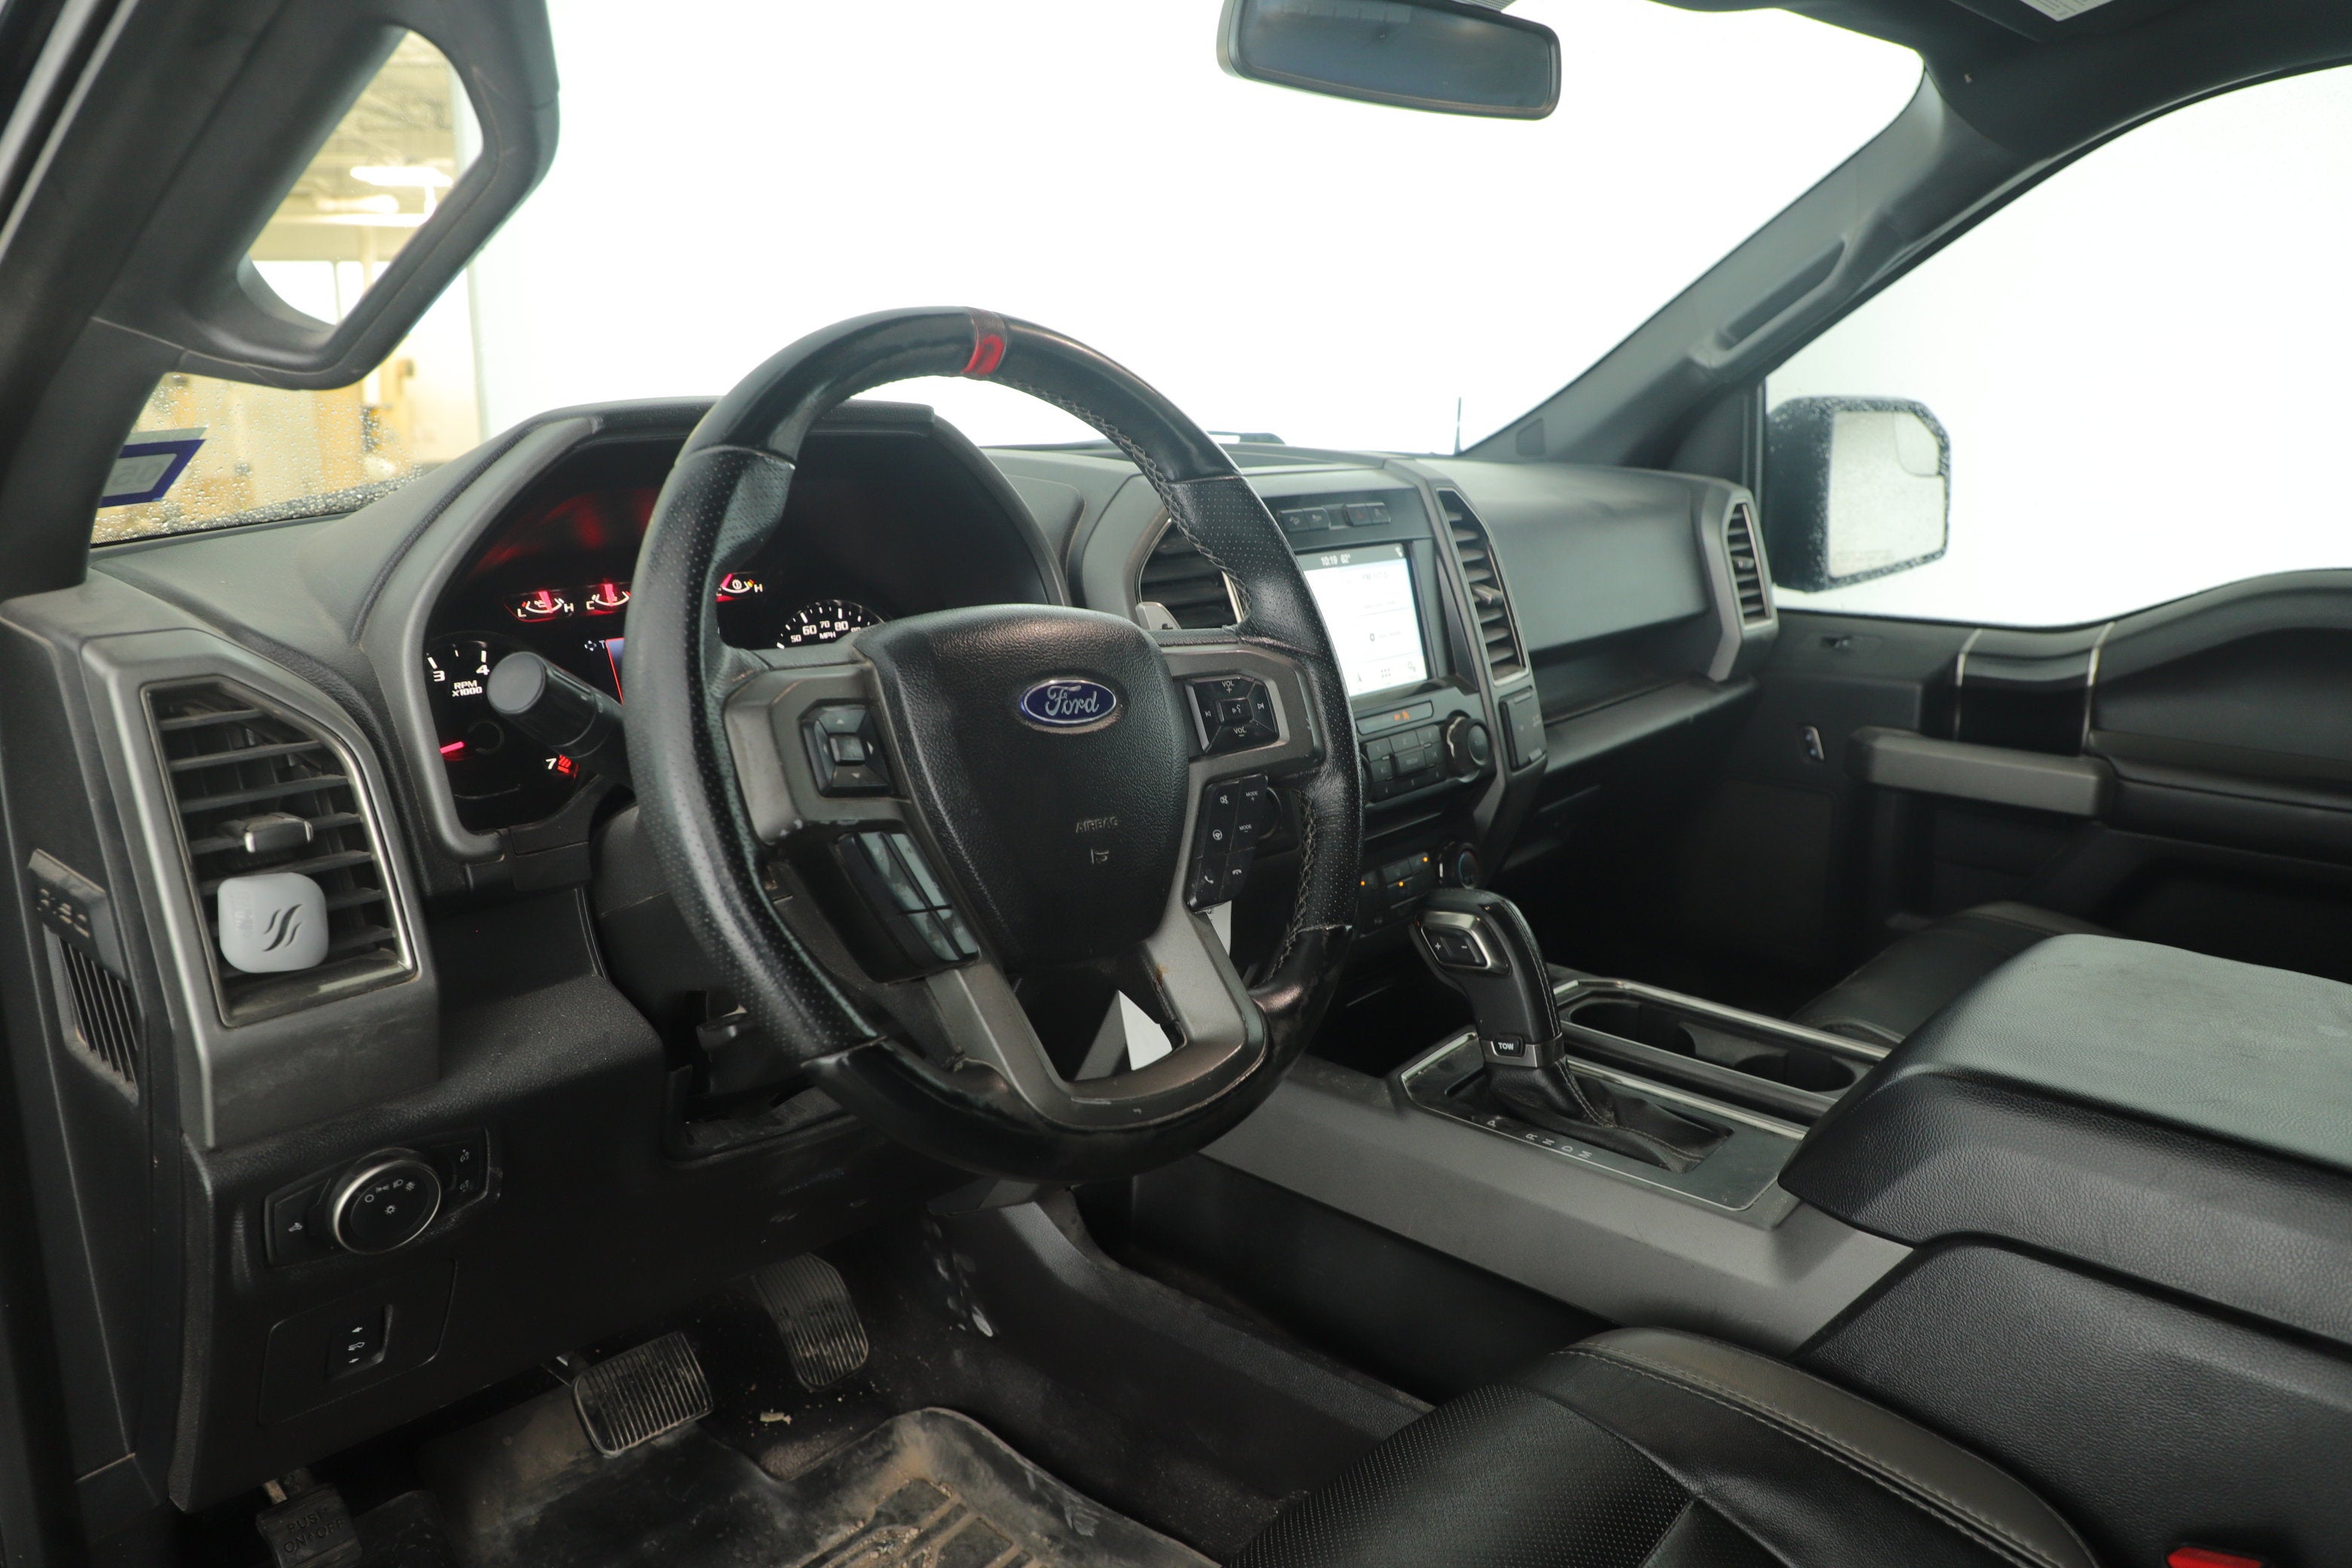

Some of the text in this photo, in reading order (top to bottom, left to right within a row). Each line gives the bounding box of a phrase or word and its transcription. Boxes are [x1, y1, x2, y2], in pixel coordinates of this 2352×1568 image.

[754, 583, 763, 593] H
[517, 608, 526, 617] L
[564, 603, 574, 613] H
[802, 624, 817, 635] 60
[819, 620, 830, 629] 70
[835, 620, 849, 631] 80
[791, 635, 801, 643] 50
[819, 631, 836, 639] MPH
[476, 665, 490, 675] 4
[433, 670, 446, 682] 3
[453, 680, 477, 690] RPM
[1045, 684, 1100, 716] Ford
[1233, 726, 1246, 735] VOL
[546, 758, 556, 770] 7
[1498, 1042, 1514, 1051] TOW
